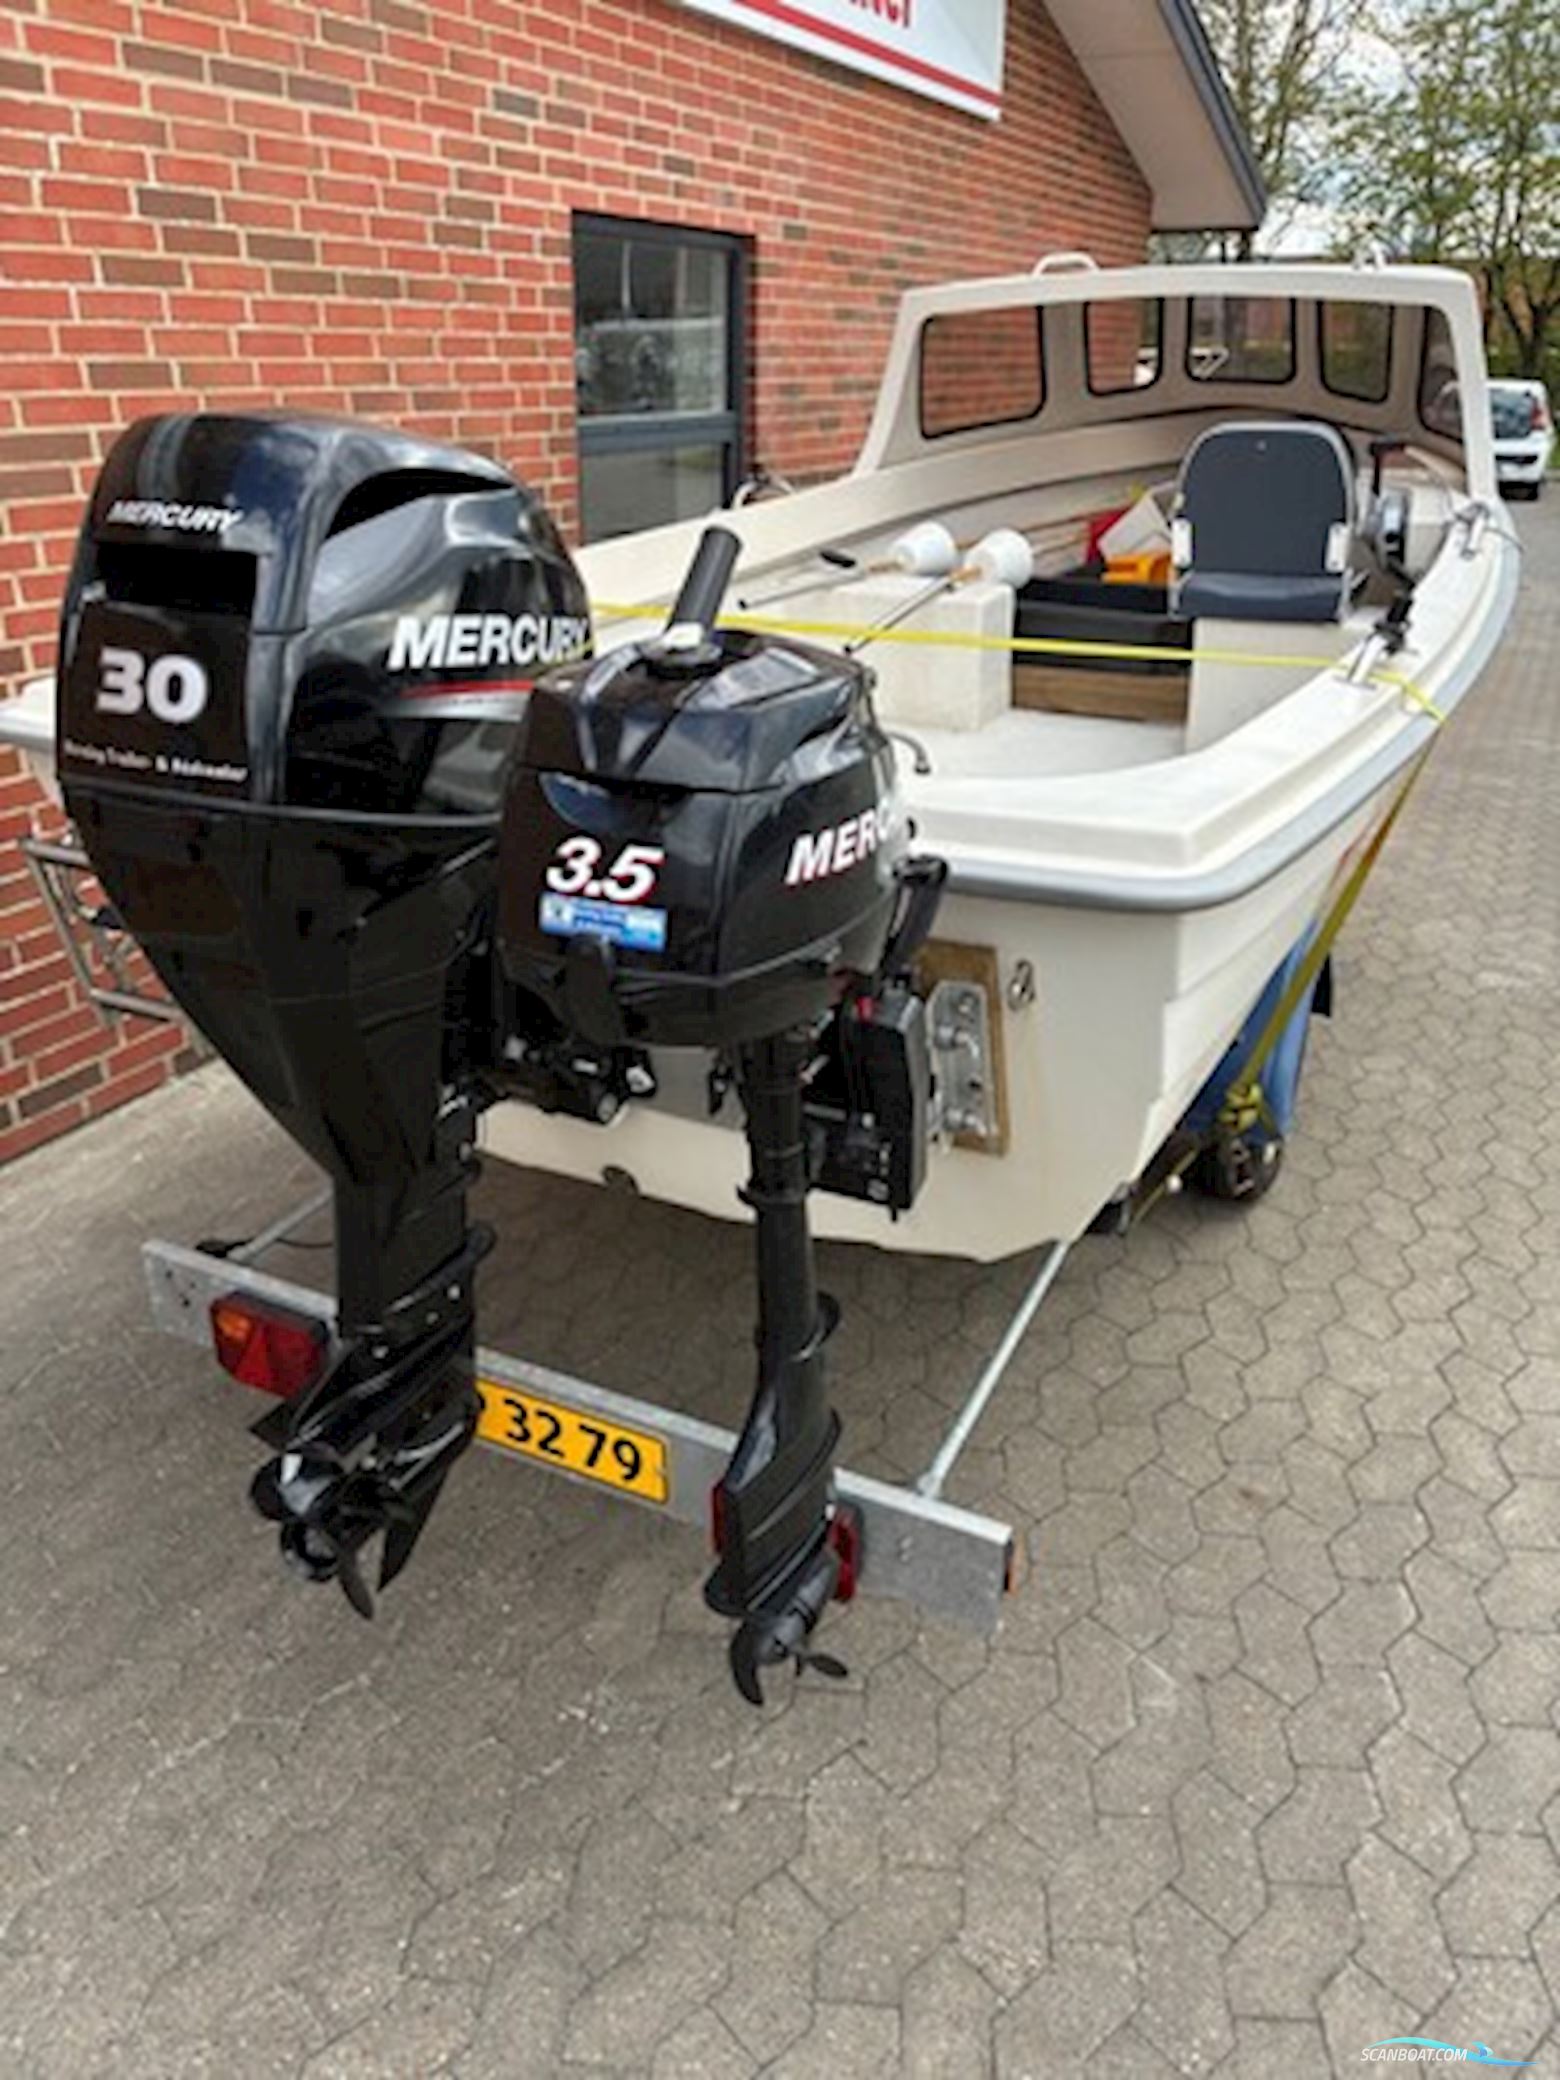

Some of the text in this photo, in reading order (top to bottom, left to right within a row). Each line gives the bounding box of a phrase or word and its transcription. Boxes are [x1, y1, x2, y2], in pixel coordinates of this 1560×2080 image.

[106, 500, 244, 533] MERCURY
[387, 613, 589, 672] MERCURY
[95, 646, 208, 723] 30
[545, 835, 665, 903] 3.5
